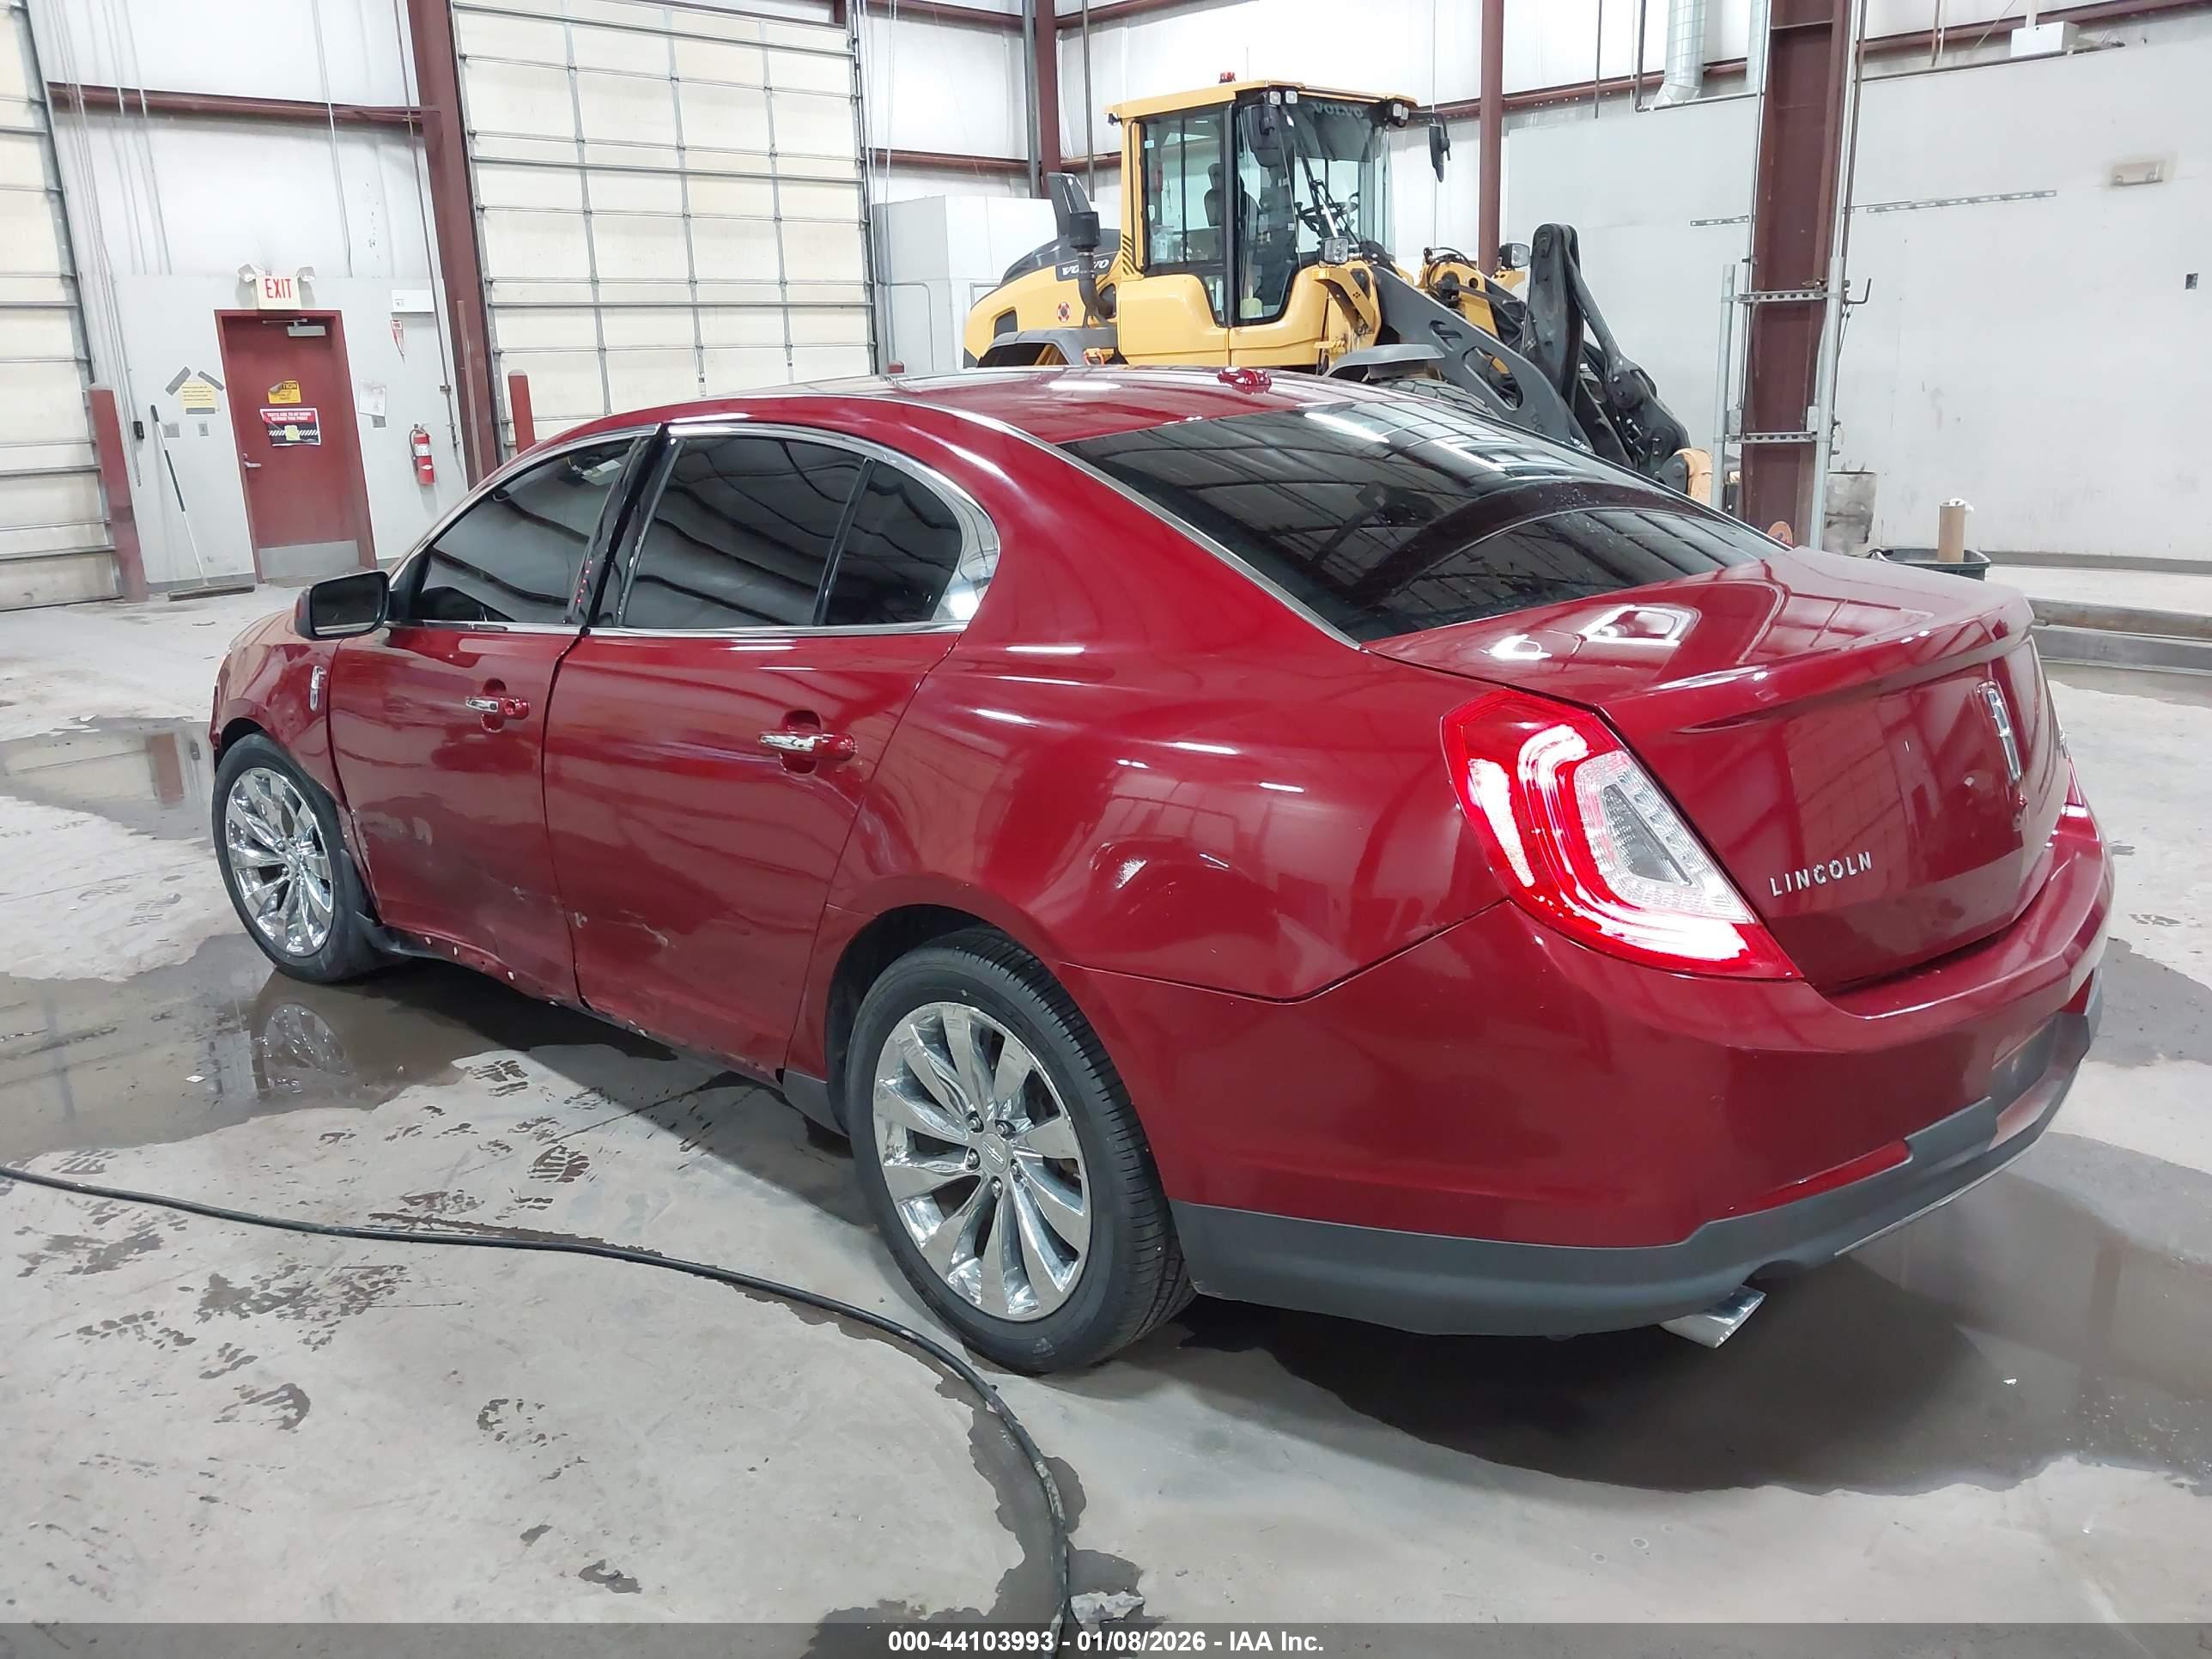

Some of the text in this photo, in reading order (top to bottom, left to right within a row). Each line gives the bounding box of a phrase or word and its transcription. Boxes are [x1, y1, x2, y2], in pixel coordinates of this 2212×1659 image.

[1310, 102, 1364, 118] VOLVO
[264, 278, 292, 299] EXIT
[1770, 851, 1872, 897] LINCOLN
